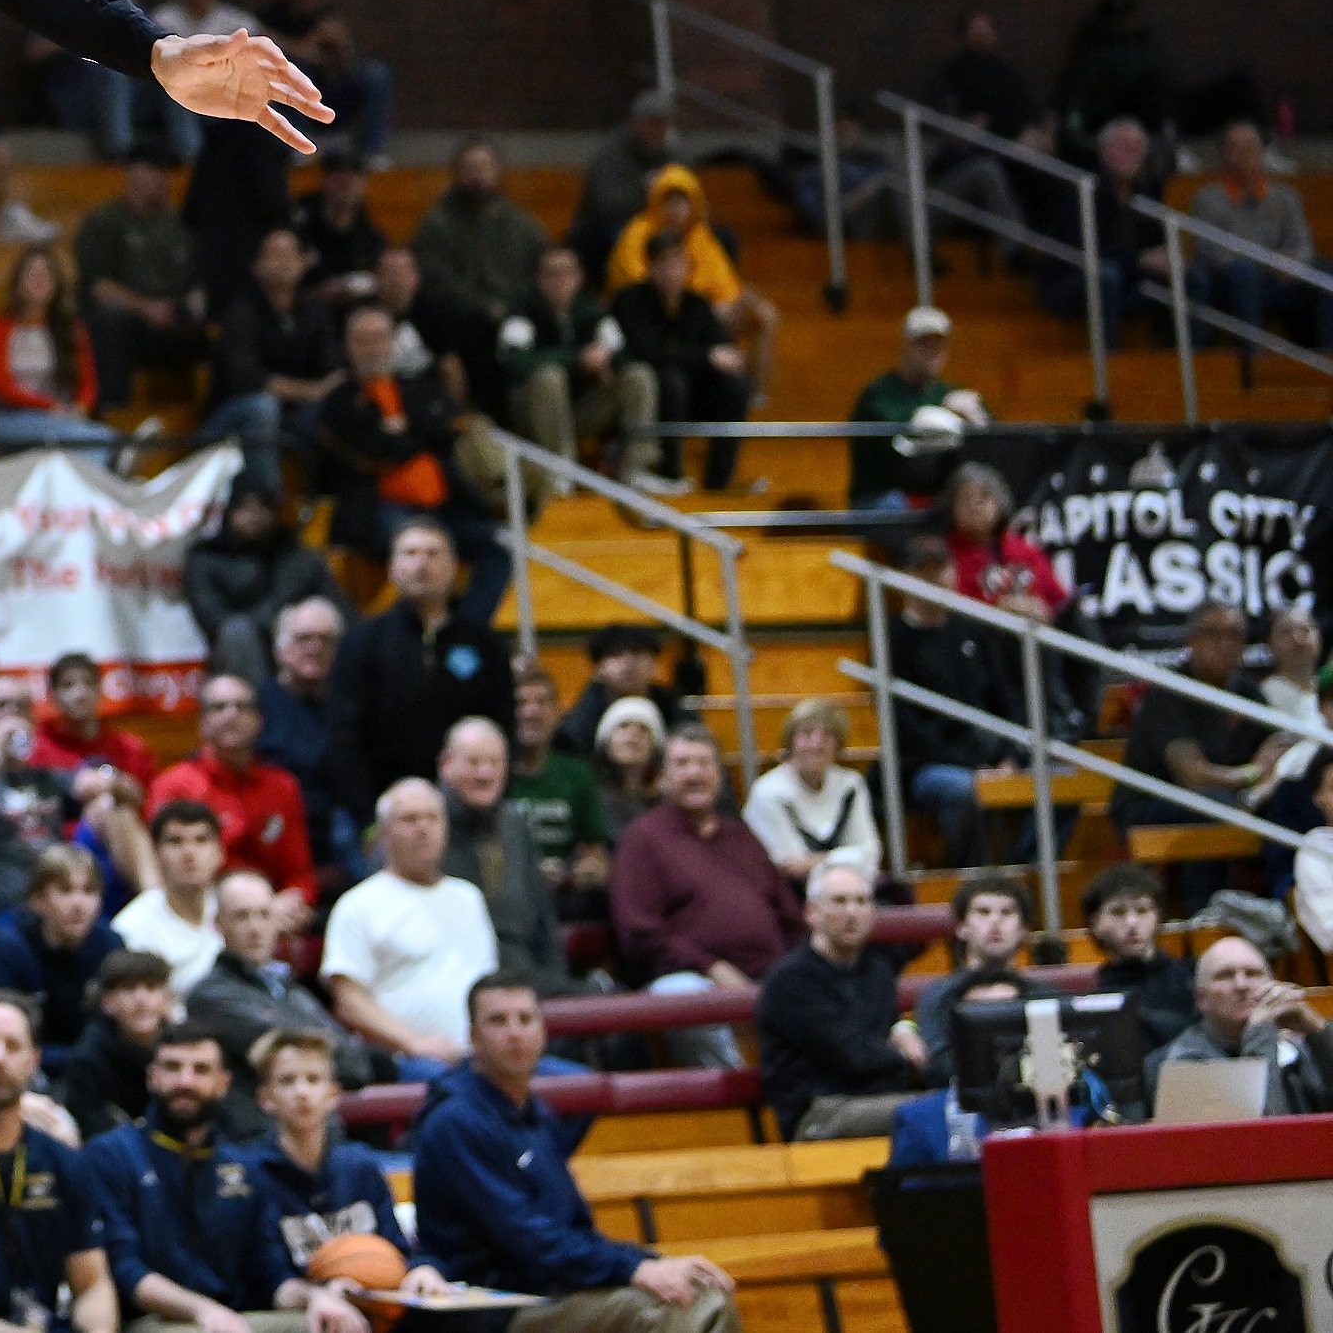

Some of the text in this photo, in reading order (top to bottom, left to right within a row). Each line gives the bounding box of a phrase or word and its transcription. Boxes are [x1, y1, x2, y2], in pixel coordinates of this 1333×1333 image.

[1005, 489, 1316, 551] CAPITOL CITY
[1050, 539, 1315, 615] LASSIC
